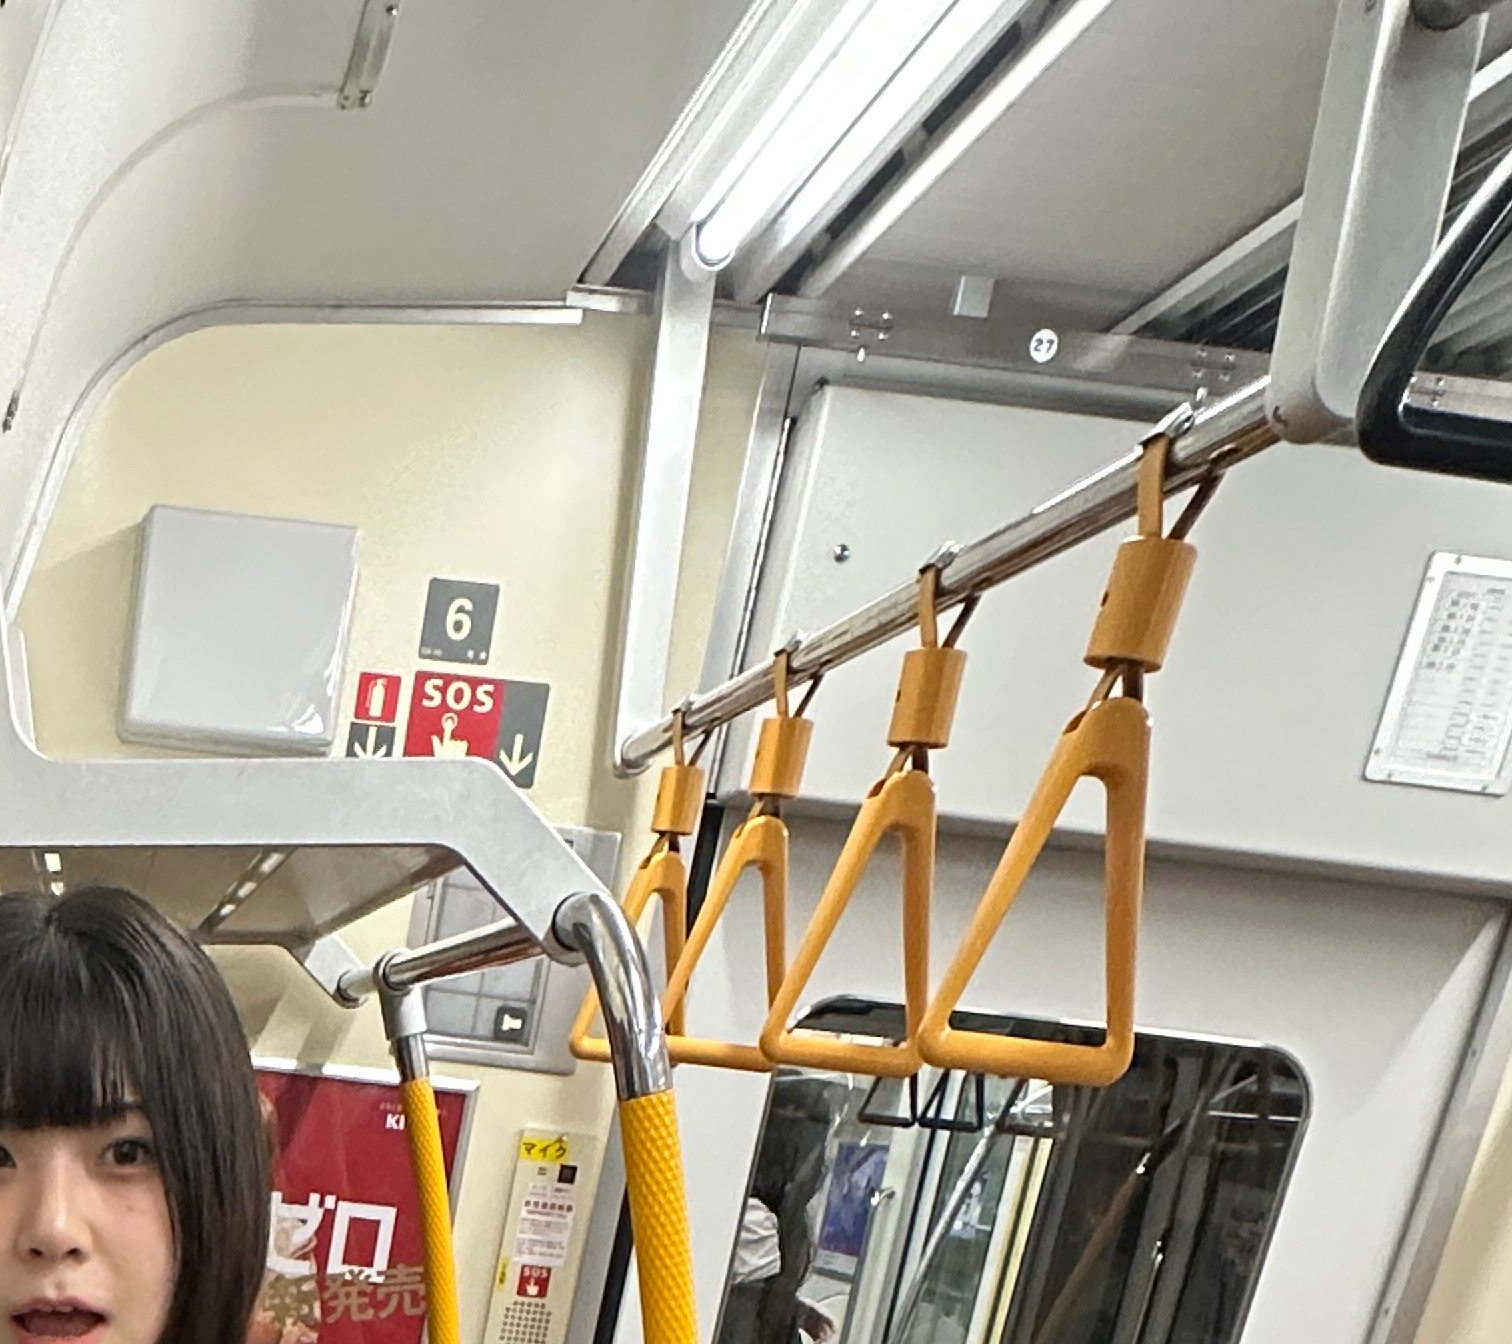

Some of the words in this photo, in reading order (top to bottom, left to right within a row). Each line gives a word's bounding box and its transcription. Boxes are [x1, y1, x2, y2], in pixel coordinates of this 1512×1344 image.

[1033, 337, 1055, 354] 27
[446, 597, 473, 641] 6
[422, 678, 495, 714] SOS
[523, 1140, 568, 1160] マイク
[522, 1265, 548, 1279] SOS
